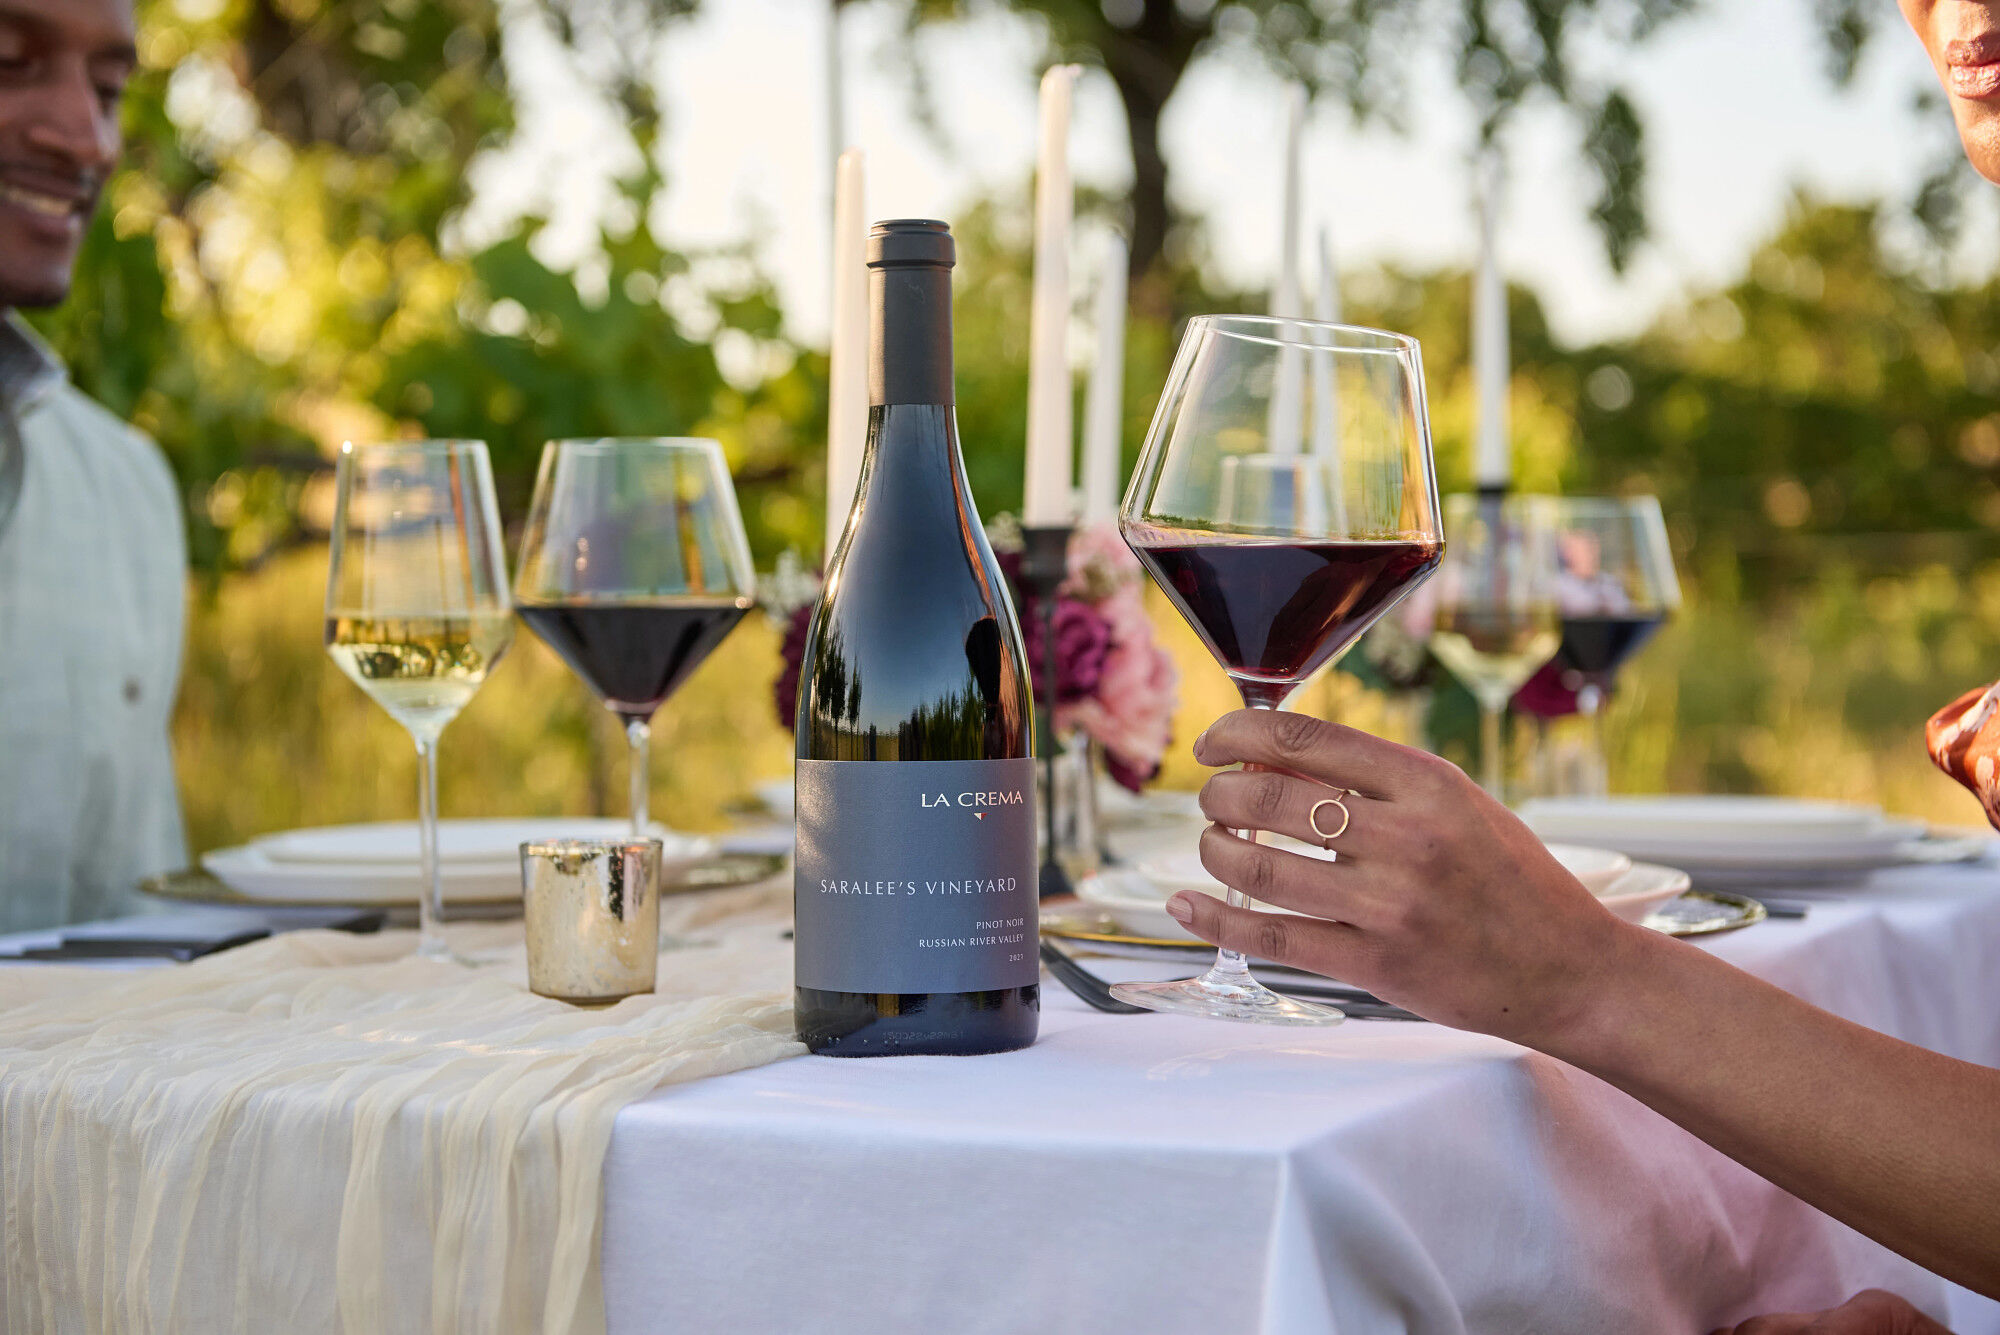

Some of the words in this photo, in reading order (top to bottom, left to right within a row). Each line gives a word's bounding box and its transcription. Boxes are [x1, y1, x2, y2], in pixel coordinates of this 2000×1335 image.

[922, 793, 950, 808] LA
[957, 791, 1024, 807] CREMA
[926, 877, 1016, 895] VINEYARD
[976, 919, 1004, 930] PINOT
[1006, 917, 1025, 928] NOIR
[919, 938, 966, 949] RUSSIAN
[970, 936, 997, 947] RIVER
[998, 934, 1024, 944] VALLEY
